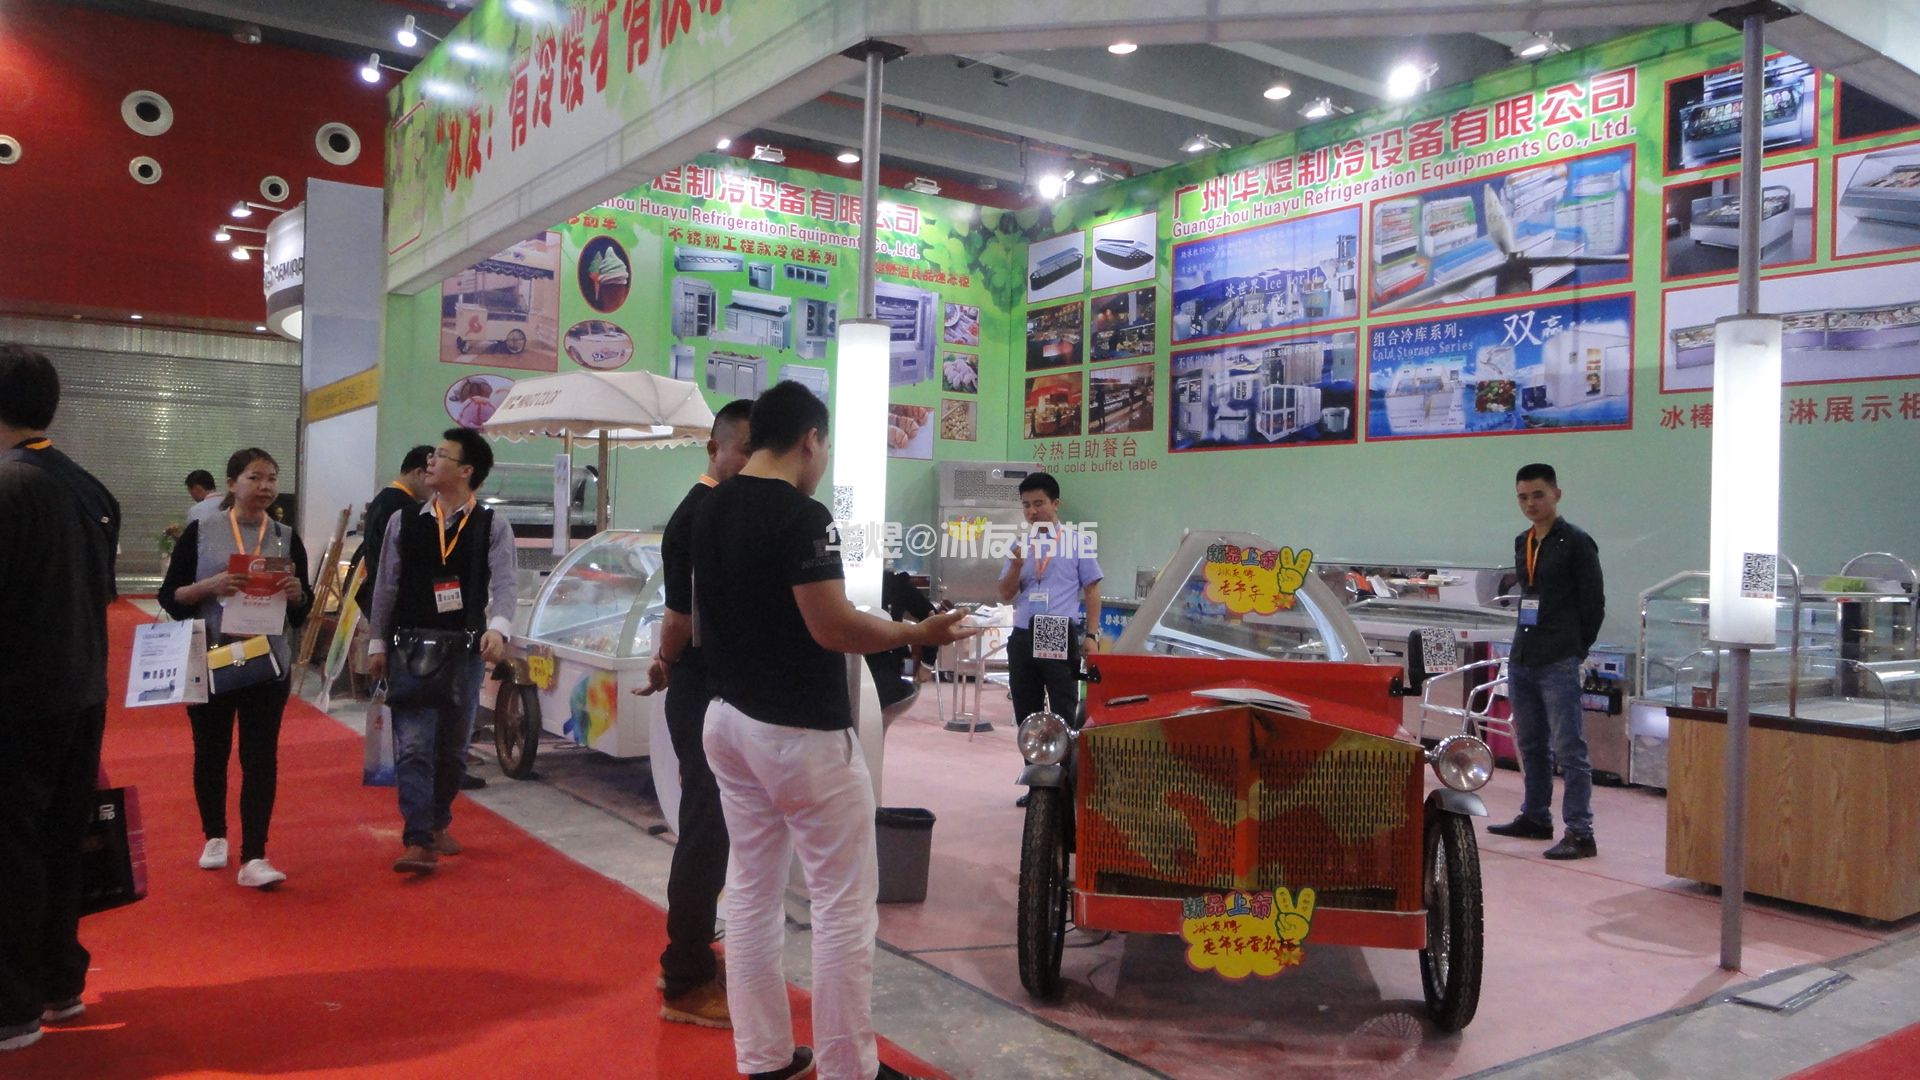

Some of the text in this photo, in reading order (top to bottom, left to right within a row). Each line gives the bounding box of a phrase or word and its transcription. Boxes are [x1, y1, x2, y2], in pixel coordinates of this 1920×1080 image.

[1173, 67, 1637, 220] 广州华煜制冷设备有限公司
[1173, 116, 1636, 237] Guangzhou Huayu Refrigeration Equipments Co.,Ltd.
[640, 198, 688, 221] Huayu
[692, 208, 786, 236] Refrigeration
[1397, 345, 1436, 358] Storage
[1439, 339, 1473, 353] Series
[1033, 436, 1137, 461] 冷热自助餐台
[1064, 461, 1086, 473] cold
[1091, 459, 1123, 472] buffet
[1129, 458, 1158, 471] table
[1206, 544, 1280, 571] 新品上市
[1182, 890, 1273, 920] 新品上市
